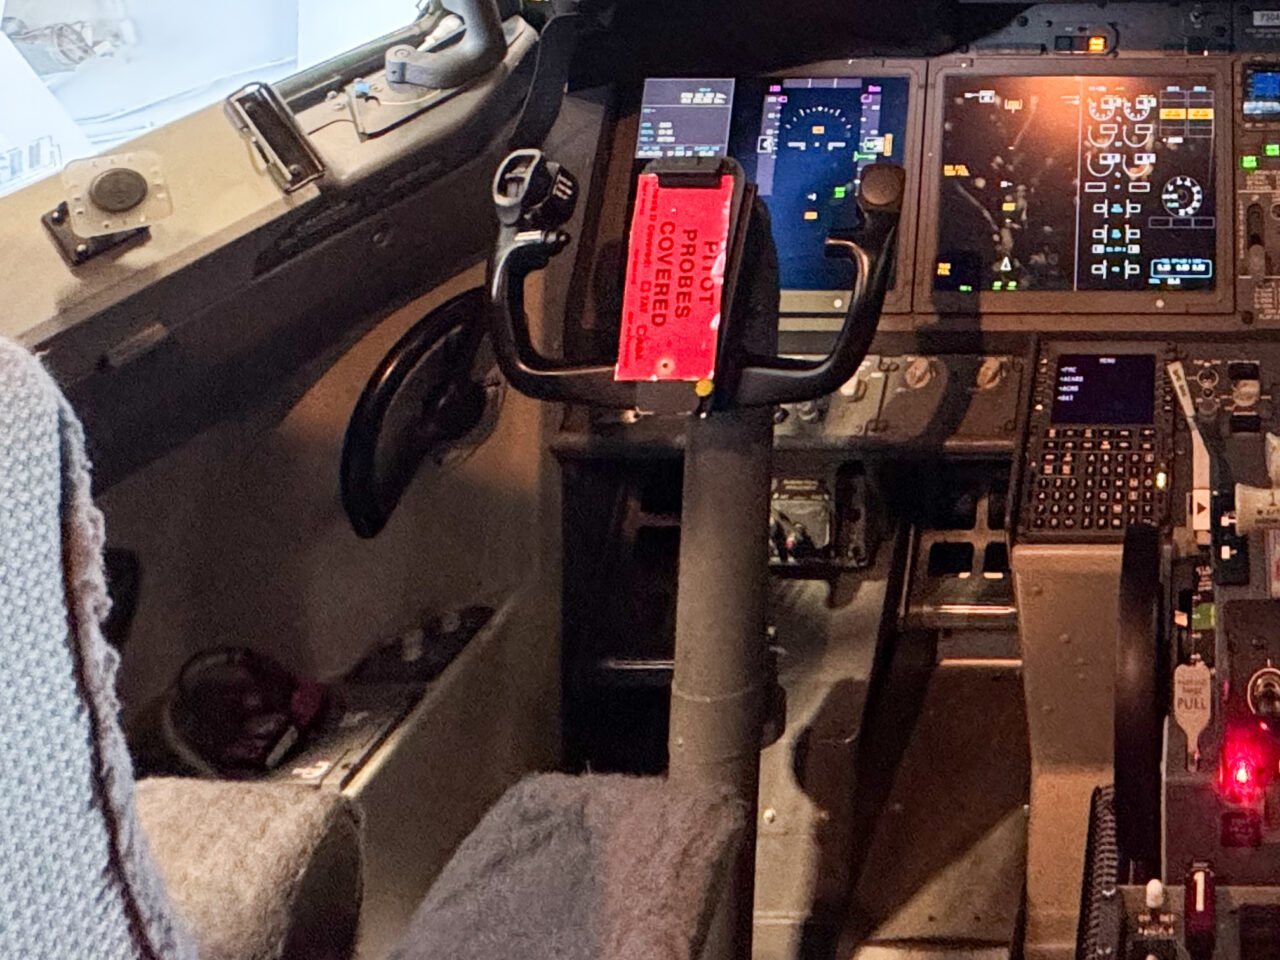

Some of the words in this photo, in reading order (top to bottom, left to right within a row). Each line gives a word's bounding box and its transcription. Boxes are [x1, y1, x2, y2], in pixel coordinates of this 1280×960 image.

[651, 221, 676, 327] COVERED
[675, 228, 698, 319] PROBES
[1268, 492, 1278, 507] 1
[1176, 697, 1208, 709] PULL
[1193, 870, 1205, 912] 1
